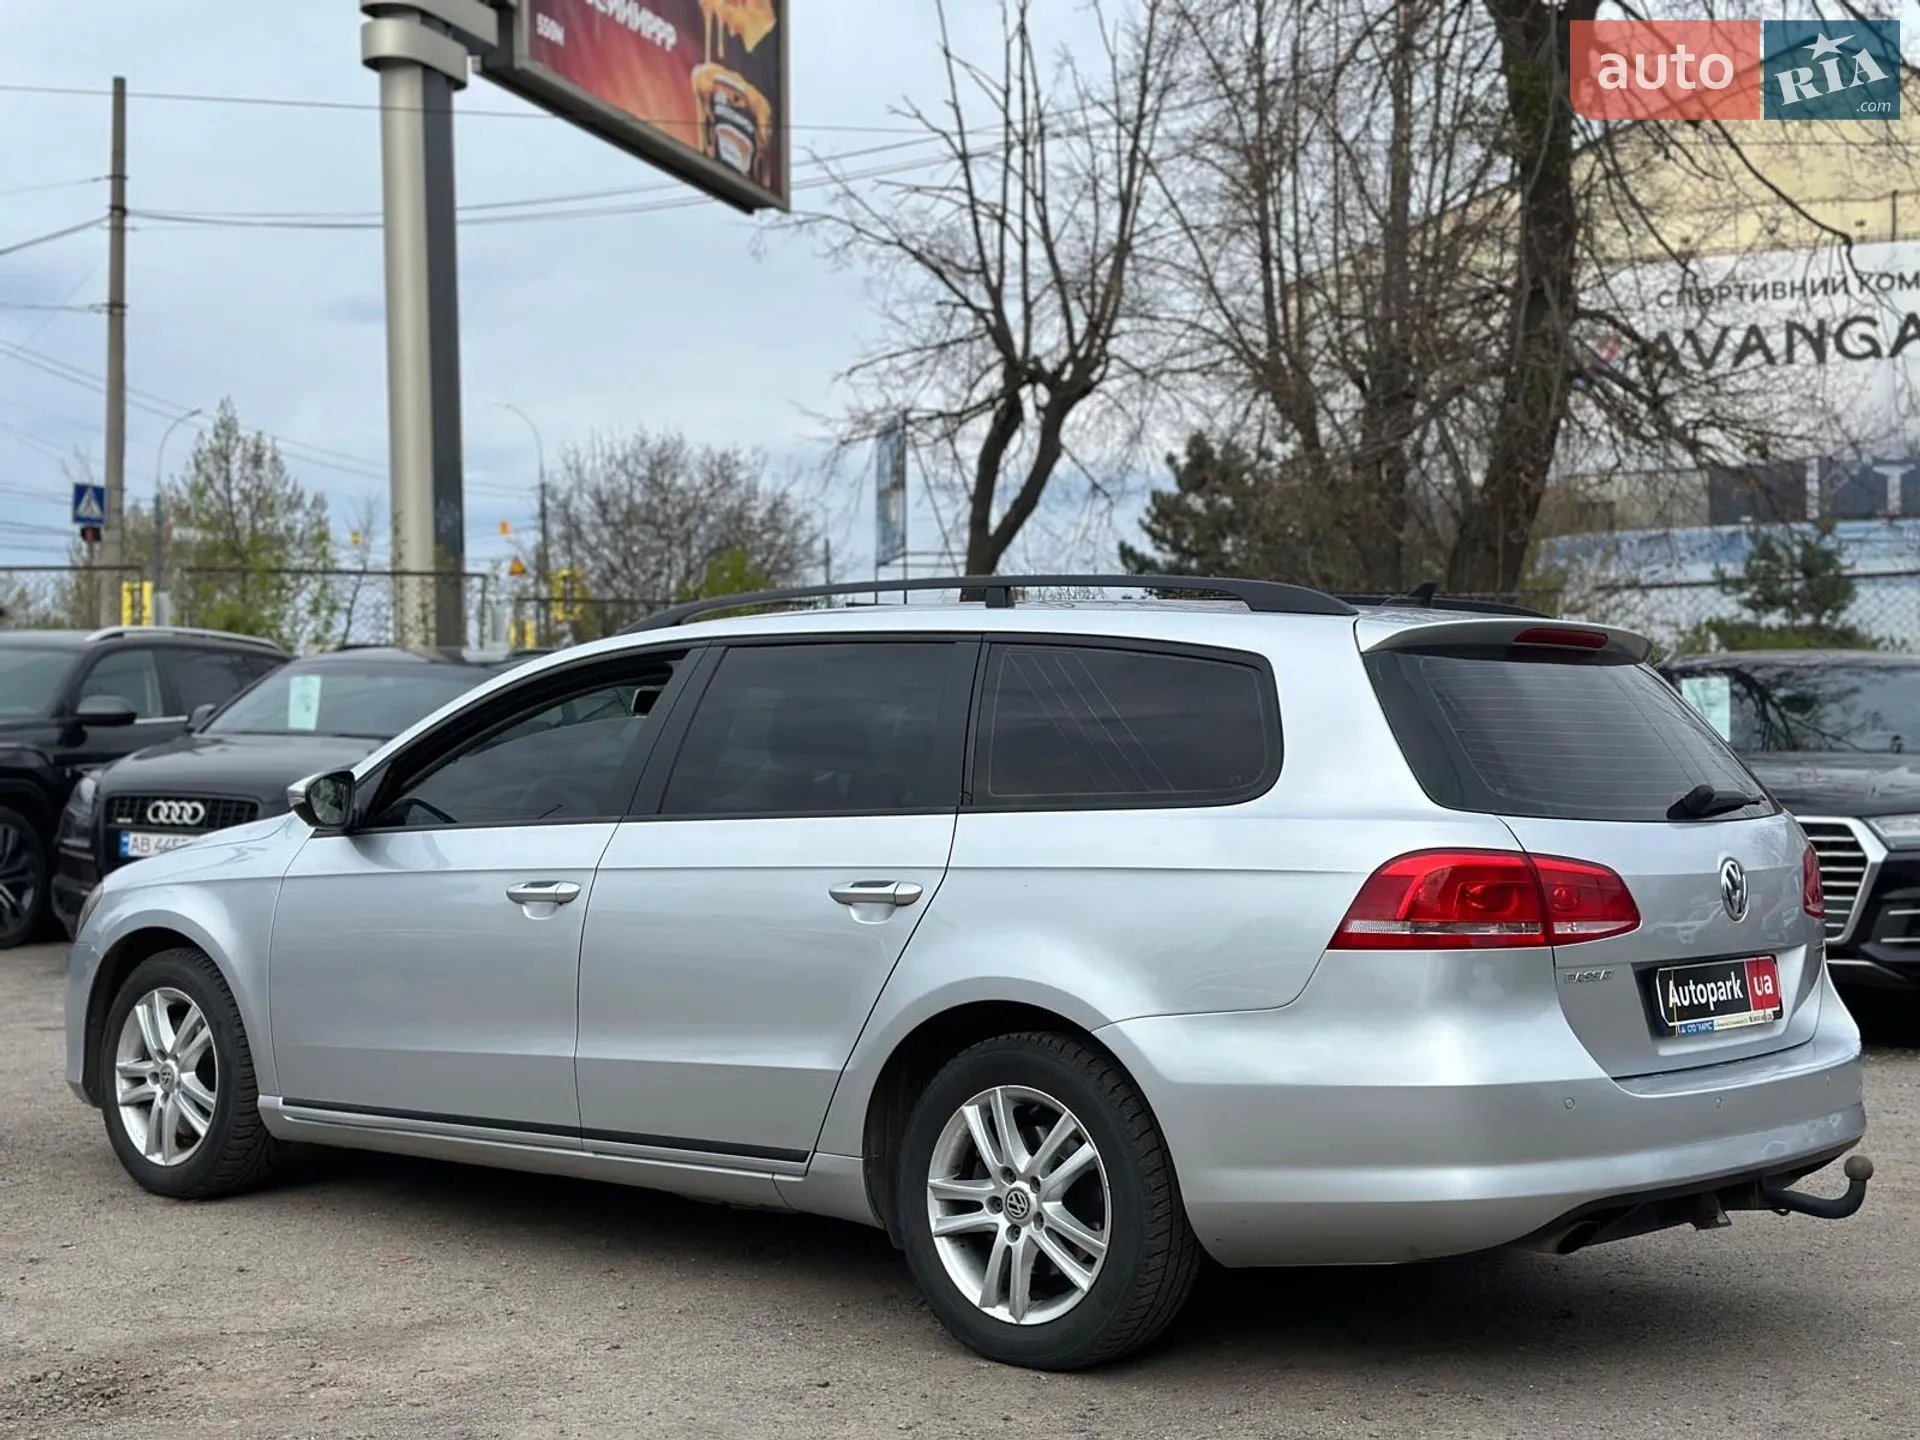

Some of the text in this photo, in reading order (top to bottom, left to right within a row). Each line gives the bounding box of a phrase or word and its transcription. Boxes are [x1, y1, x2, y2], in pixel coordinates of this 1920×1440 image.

[1656, 271, 1850, 309] СПОРТИВНИЙ
[1668, 971, 1774, 1011] Autopark ua
